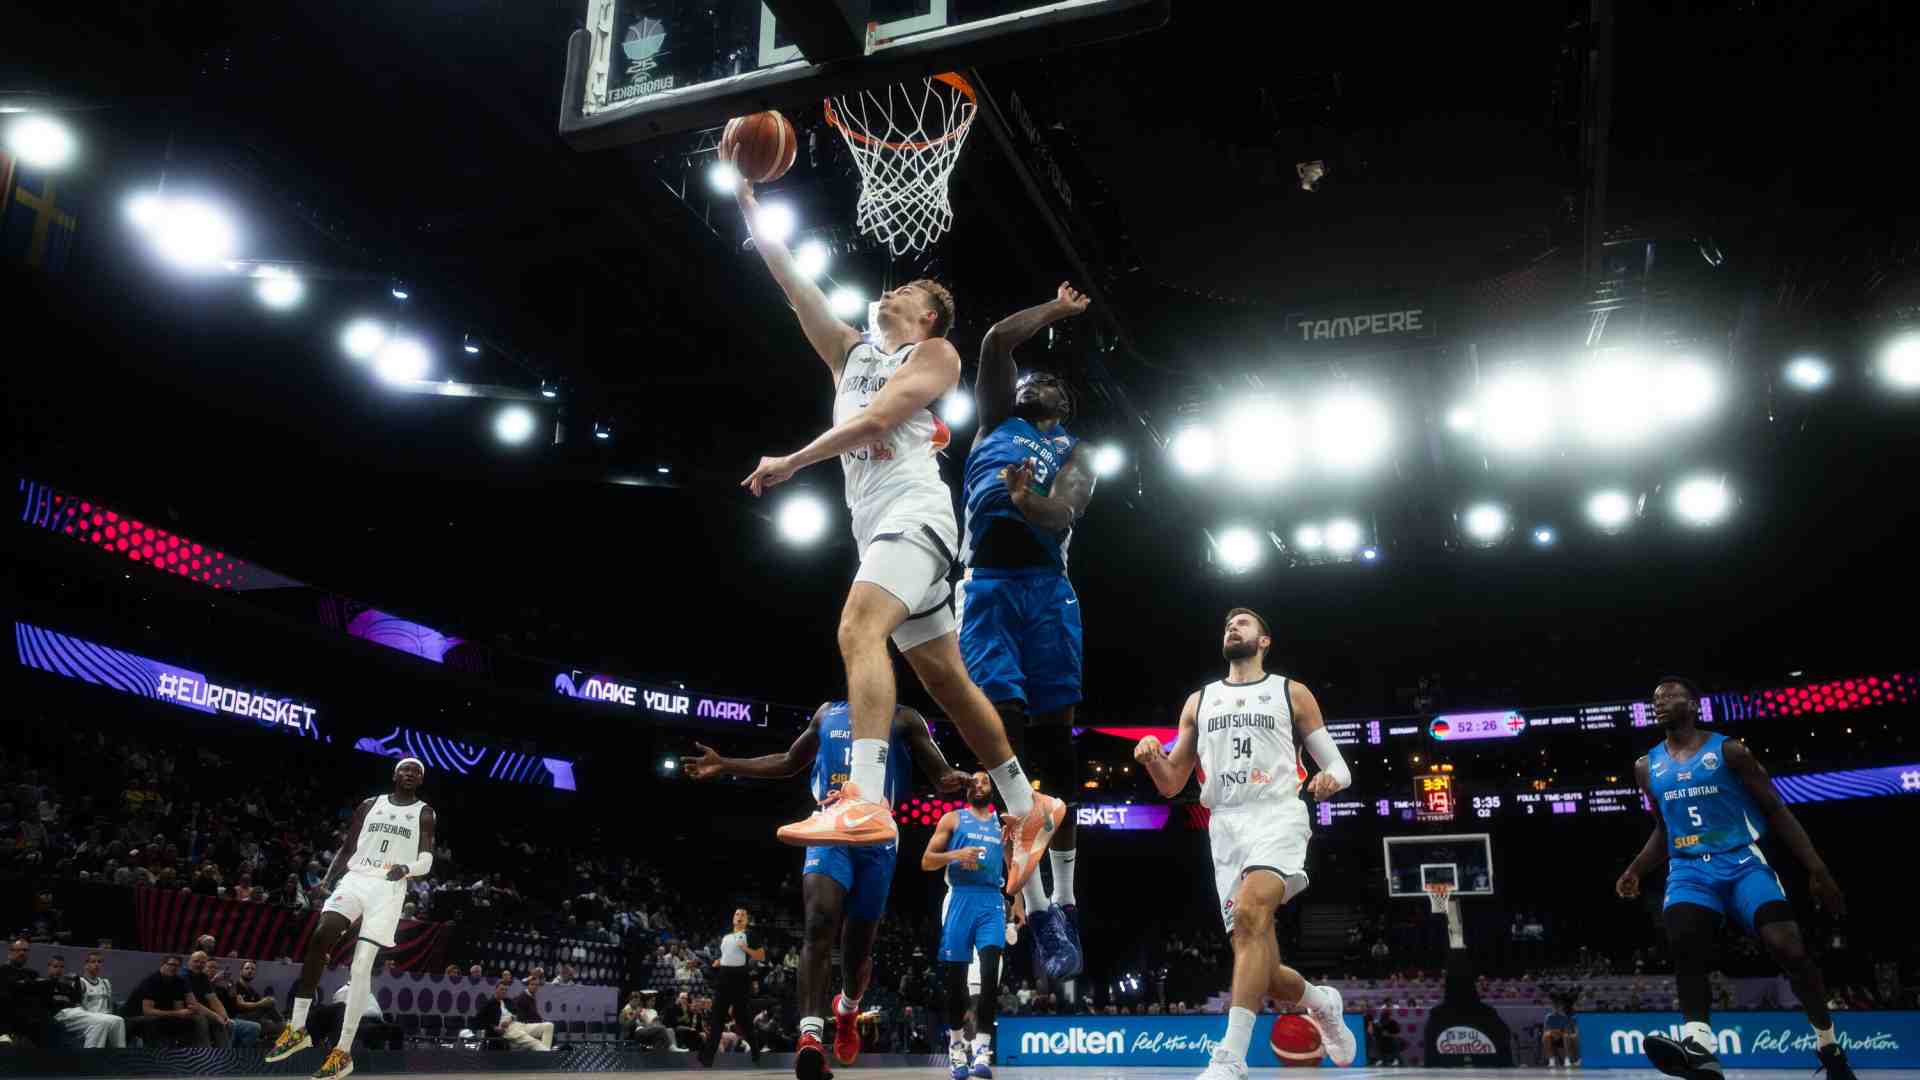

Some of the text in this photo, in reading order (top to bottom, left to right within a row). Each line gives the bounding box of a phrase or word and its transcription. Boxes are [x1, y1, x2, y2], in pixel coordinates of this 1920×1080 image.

[1298, 309, 1423, 340] TAMPERE
[157, 672, 317, 730] #EUROBASKET
[585, 679, 751, 722] MAKE YOUR MARK
[1207, 712, 1275, 733] DEUTSCHLAND
[1458, 721, 1473, 732] 52
[1482, 719, 1497, 731] 26
[1232, 736, 1252, 760] 34
[1220, 770, 1248, 787] ING
[1517, 793, 1541, 802] FOULS
[1664, 784, 1719, 801] GREAT BRITAIN
[1472, 796, 1501, 809] 3:35
[1076, 807, 1129, 825] SKET
[1687, 805, 1703, 827] 5
[368, 822, 412, 840] DEUTSCHLAND
[379, 839, 389, 853] 0
[1021, 1027, 1125, 1055] molten
